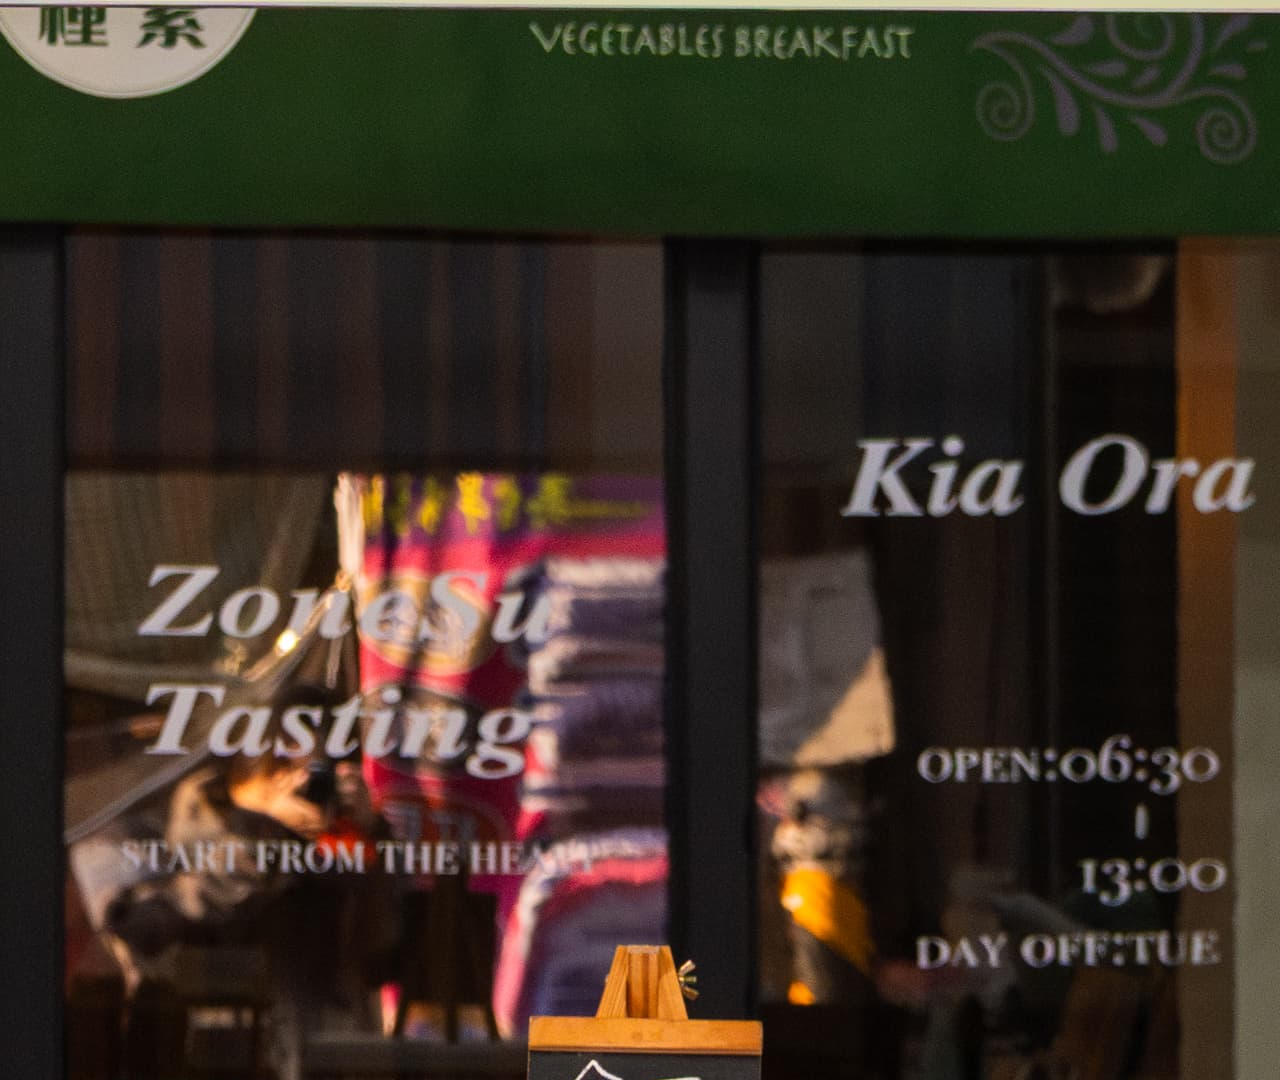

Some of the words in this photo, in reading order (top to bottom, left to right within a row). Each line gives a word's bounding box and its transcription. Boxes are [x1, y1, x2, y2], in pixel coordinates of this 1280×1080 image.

[528, 21, 724, 58] VEGETABLES
[733, 22, 916, 61] BREAKFAST
[839, 434, 1025, 518] Kia
[1058, 432, 1257, 516] Ora
[136, 562, 558, 643] ZoneSu
[143, 682, 535, 780] Tasting
[917, 734, 1220, 796] OPEN:06:30
[120, 838, 243, 876] START
[254, 839, 366, 876] FROM
[375, 839, 460, 876] THE
[1076, 857, 1227, 907] 13:00
[916, 936, 1008, 970] DAY
[1019, 930, 1220, 968] OFF:TUE
